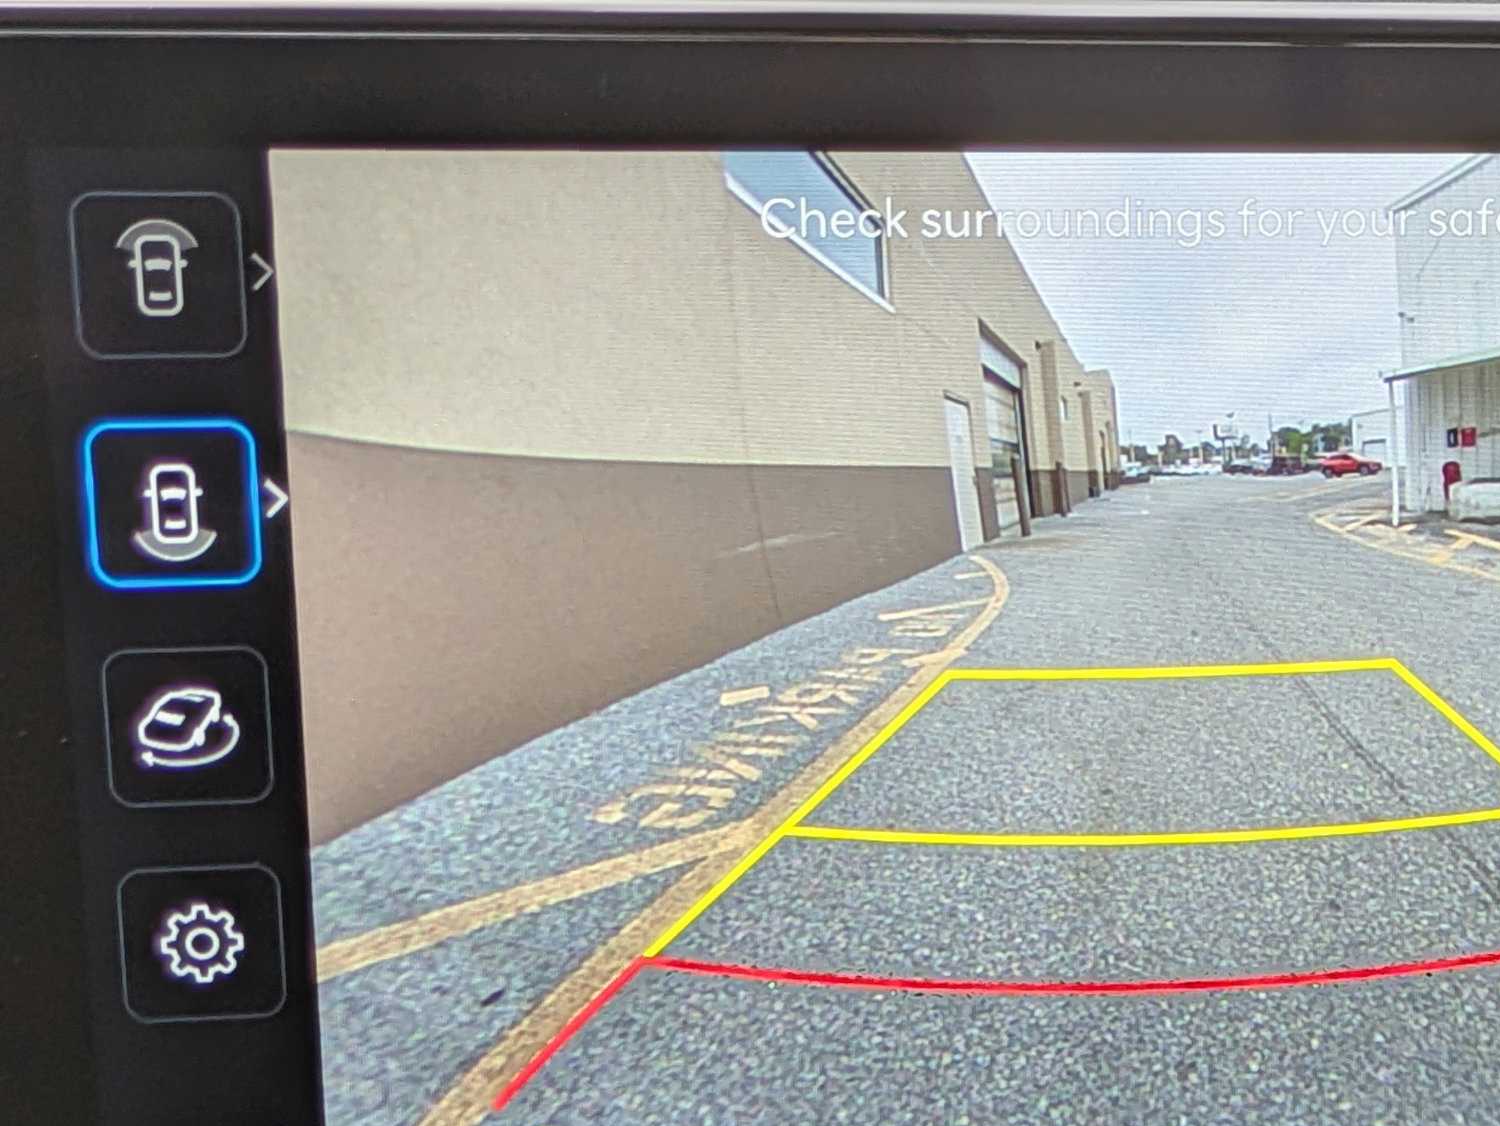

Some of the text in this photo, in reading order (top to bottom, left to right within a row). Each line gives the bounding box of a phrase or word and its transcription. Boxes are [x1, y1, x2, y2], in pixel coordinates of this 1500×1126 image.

[760, 196, 907, 240] Check
[921, 197, 1226, 248] surroundings
[1237, 197, 1304, 238] for
[1316, 206, 1414, 246] your
